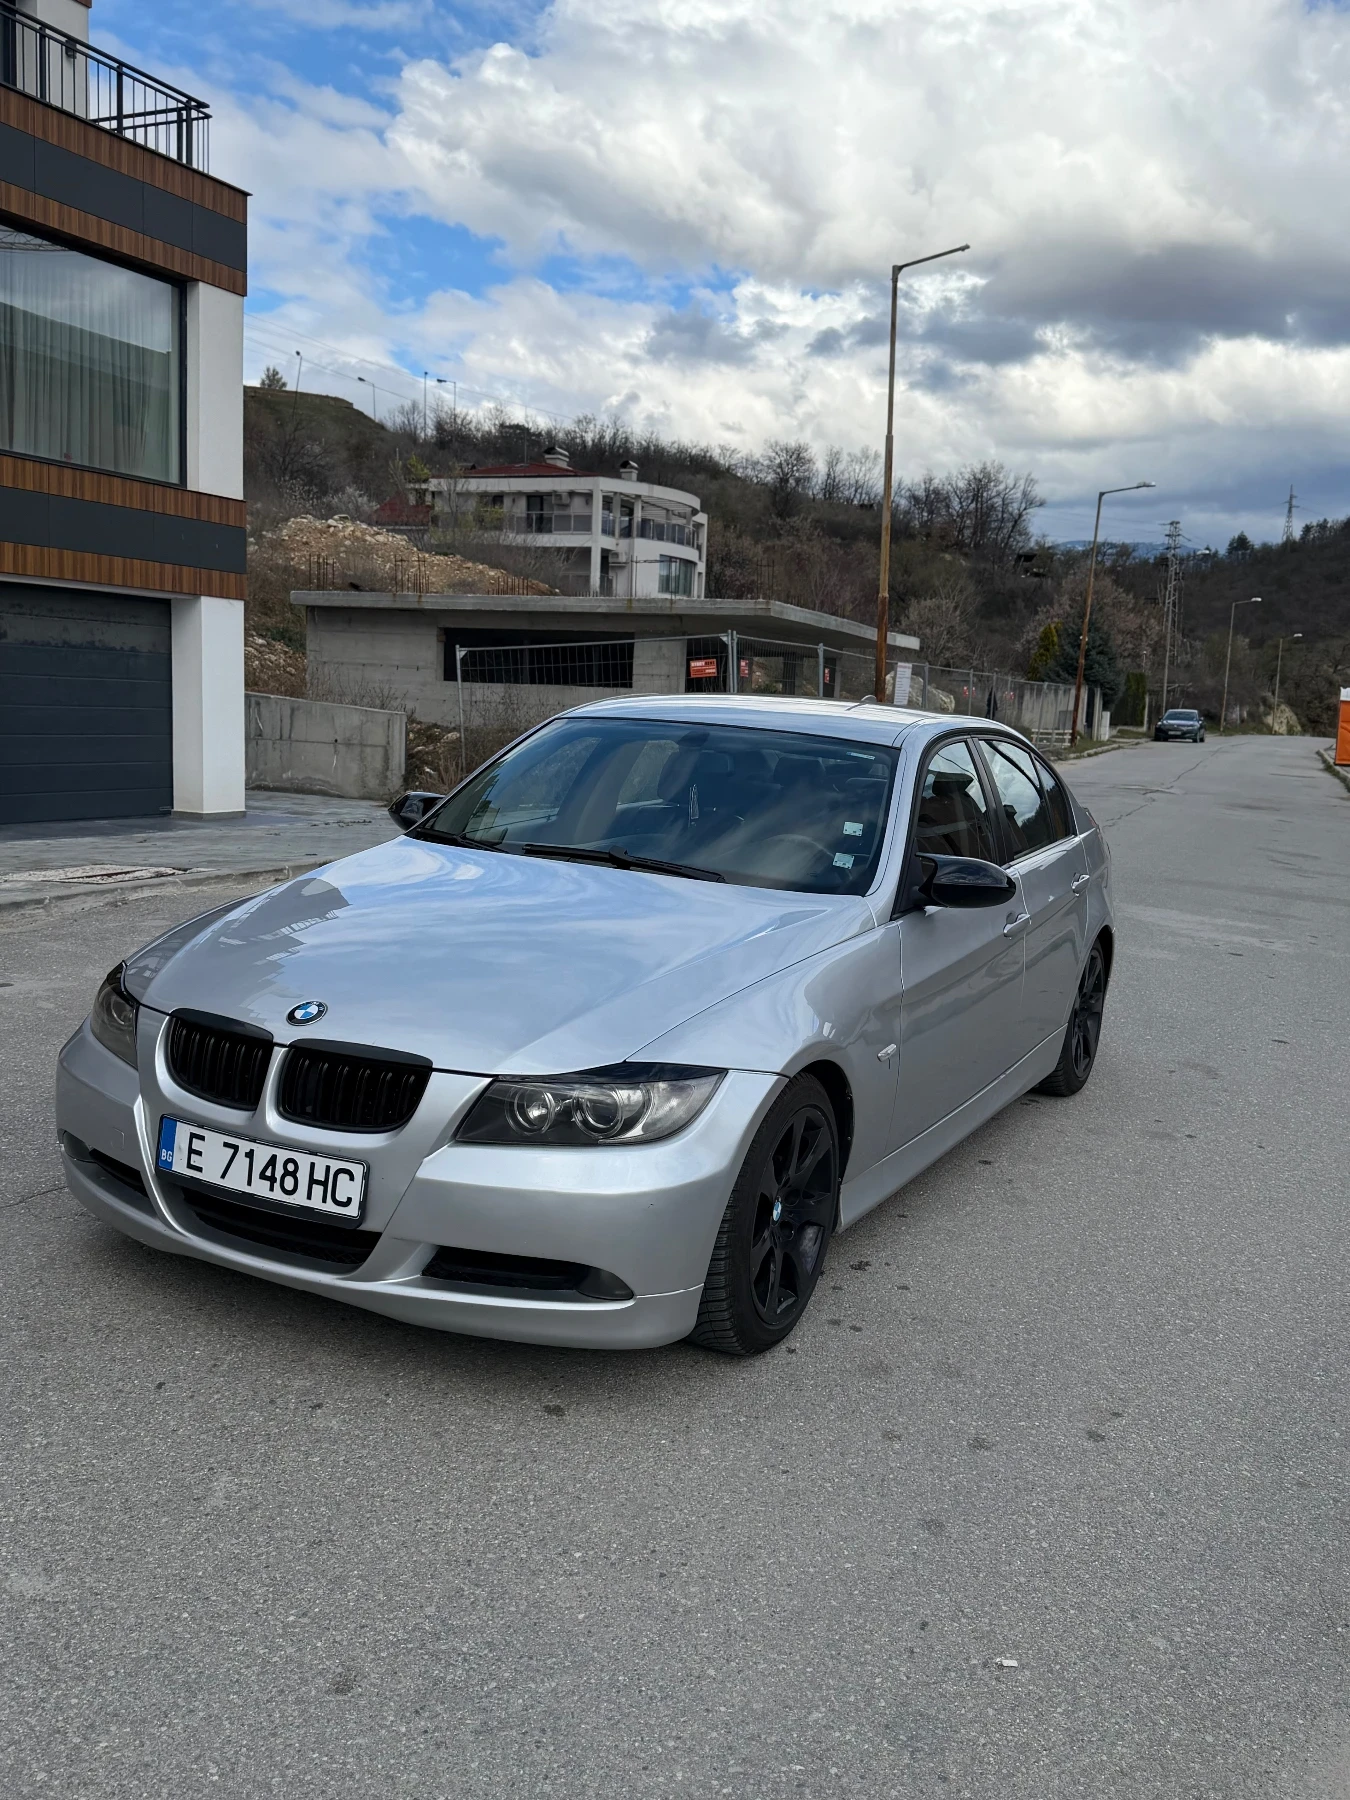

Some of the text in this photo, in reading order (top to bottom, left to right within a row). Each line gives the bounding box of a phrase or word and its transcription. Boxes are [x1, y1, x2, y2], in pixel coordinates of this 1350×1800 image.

[161, 1148, 173, 1163] BG
[186, 1131, 355, 1208] E 7148 HC
